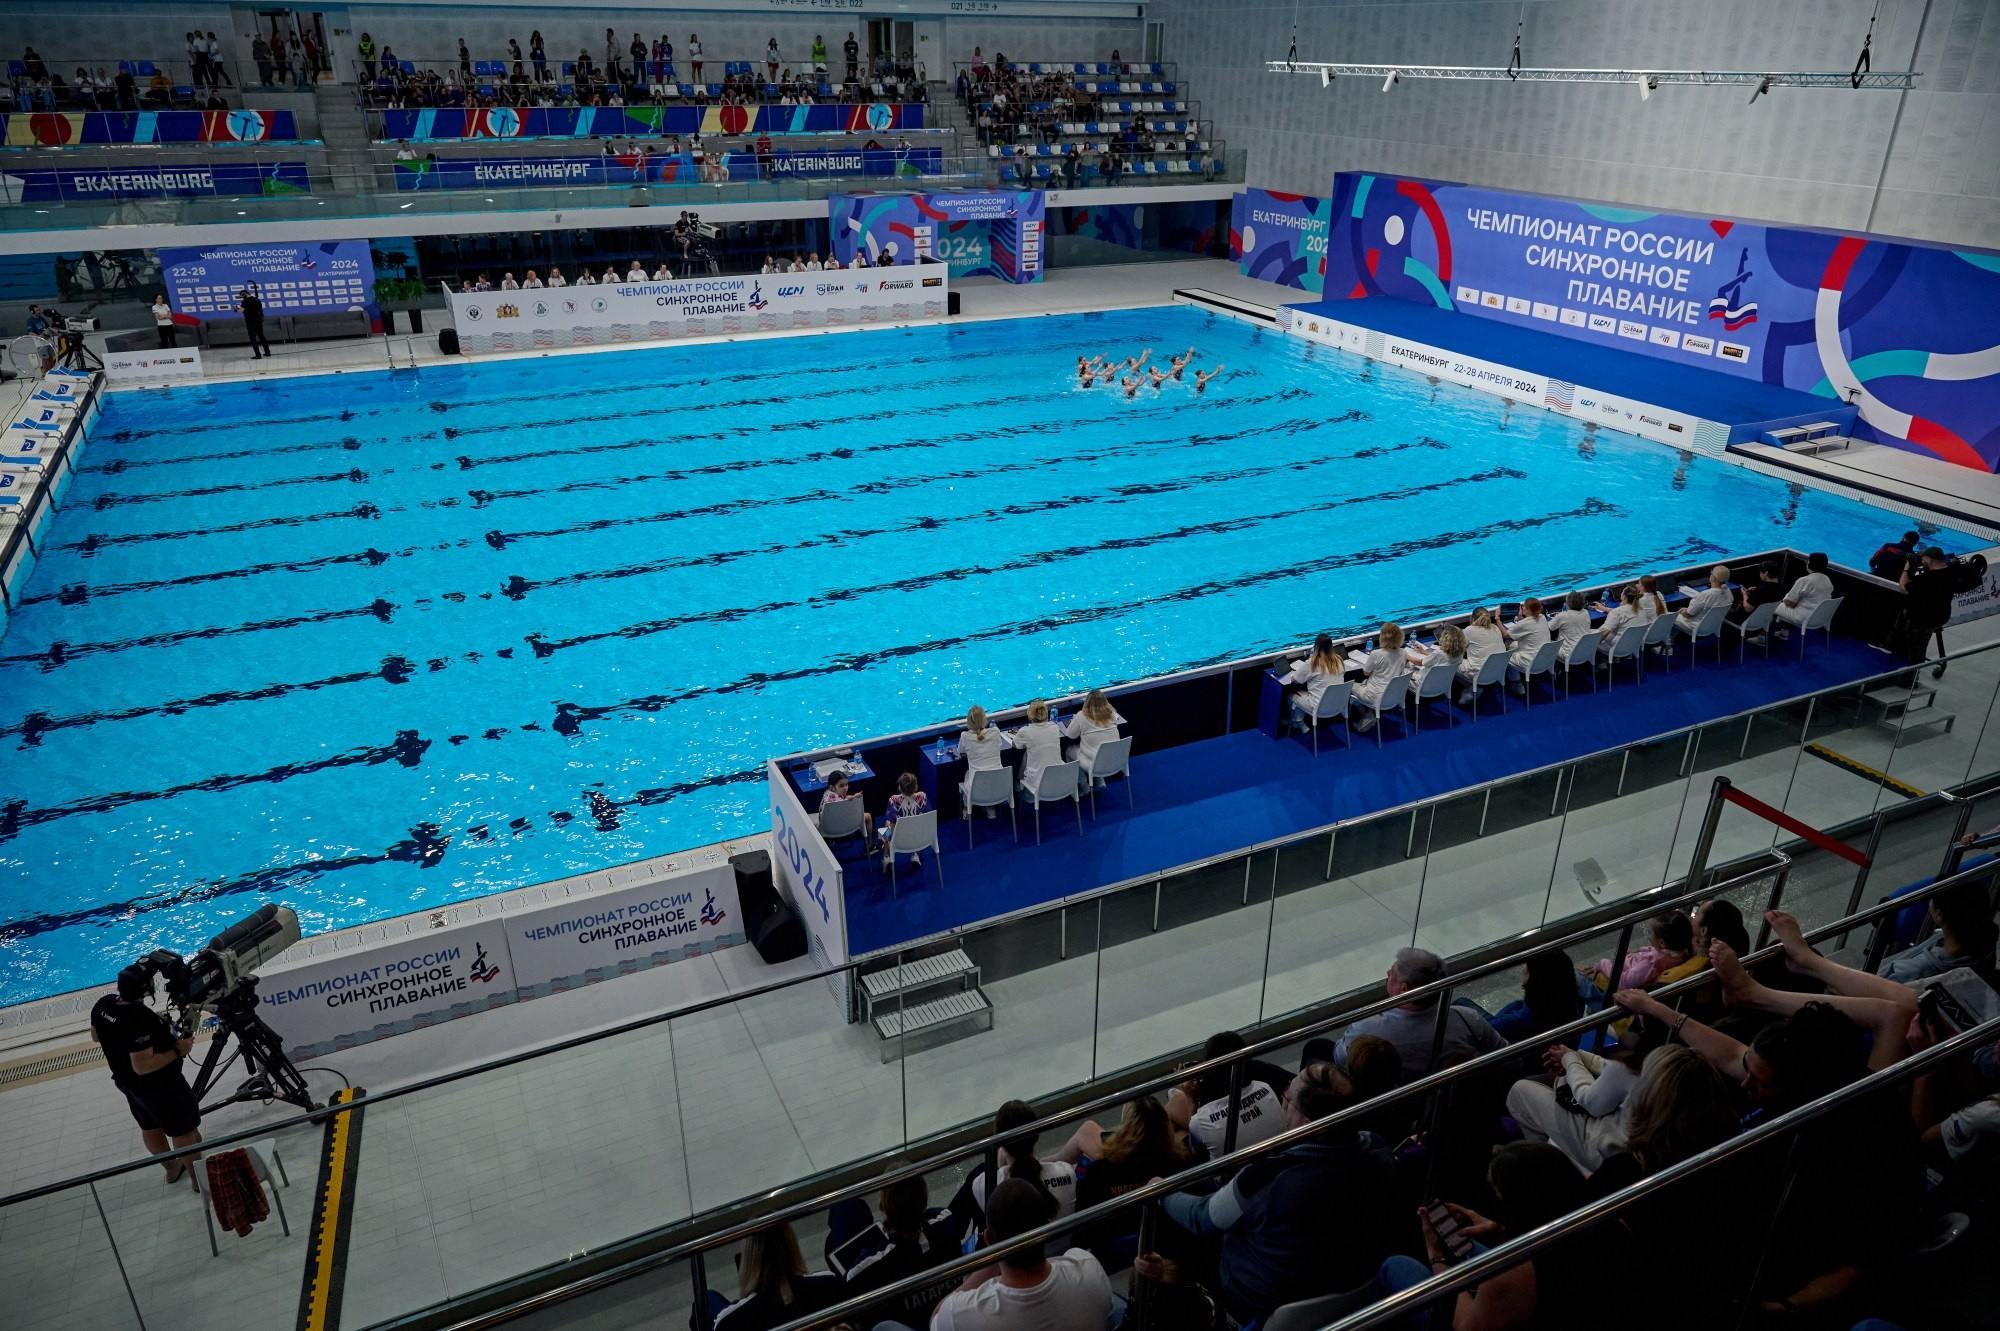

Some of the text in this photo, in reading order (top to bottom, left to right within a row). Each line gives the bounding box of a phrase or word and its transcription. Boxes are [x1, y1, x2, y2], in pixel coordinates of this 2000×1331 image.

[474, 163, 590, 180] ЕКАТЕРИНБУРГ
[771, 156, 861, 172] KATERINBURG
[74, 173, 214, 192] EKATERINBURG
[936, 198, 1006, 207] ЧЕМПИОНАТ РОССИИ
[957, 205, 1002, 213] СИНХРОННОЕ
[1253, 210, 1326, 232] ЕКАТЕРИНБУРГ
[1306, 236, 1329, 253] 202
[1467, 208, 1715, 265] ЧЕМПИОНАТ РОССИИ
[200, 249, 297, 260] ЧЕМПИОНАТ РОССИИ
[937, 236, 982, 258] 024
[231, 257, 293, 266] СИНХРОННОЕ
[252, 265, 300, 273] ПЛАВАНИЕ
[331, 260, 359, 269] 2024
[1526, 245, 1691, 292] СИНХРОННОЕ
[172, 267, 206, 277] 22-28
[617, 281, 745, 297] ЧЕМПИОНАТ РОССИИ
[879, 280, 914, 291] FORWARD
[656, 292, 737, 306] СИНХРОННОЕ
[1567, 279, 1702, 325] ПЛАВАНИЕ
[683, 303, 746, 316] ПЛАВАНИЕ
[1391, 346, 1537, 394] ЕКАТЕРИНБУРГ 22-28 АПРЕЛЯ 2024
[25, 441, 32, 450] 2
[4, 476, 11, 486] 3
[1958, 594, 1990, 607] ПЛАВАНИЕ
[776, 805, 830, 924] 2024
[524, 892, 692, 941] ЧЕМПИОНАТ РОССИИ
[578, 908, 685, 944] СИНХРОННОЕ
[615, 920, 697, 950] ПЛАВАНИЕ
[262, 947, 461, 1007] ЧЕМПИОНАТ РОССИИ
[327, 965, 453, 1008] СИНХРОННОЕ
[369, 977, 467, 1013] ПЛАВАНИЕ
[1240, 1105, 1263, 1124] КРАЙ
